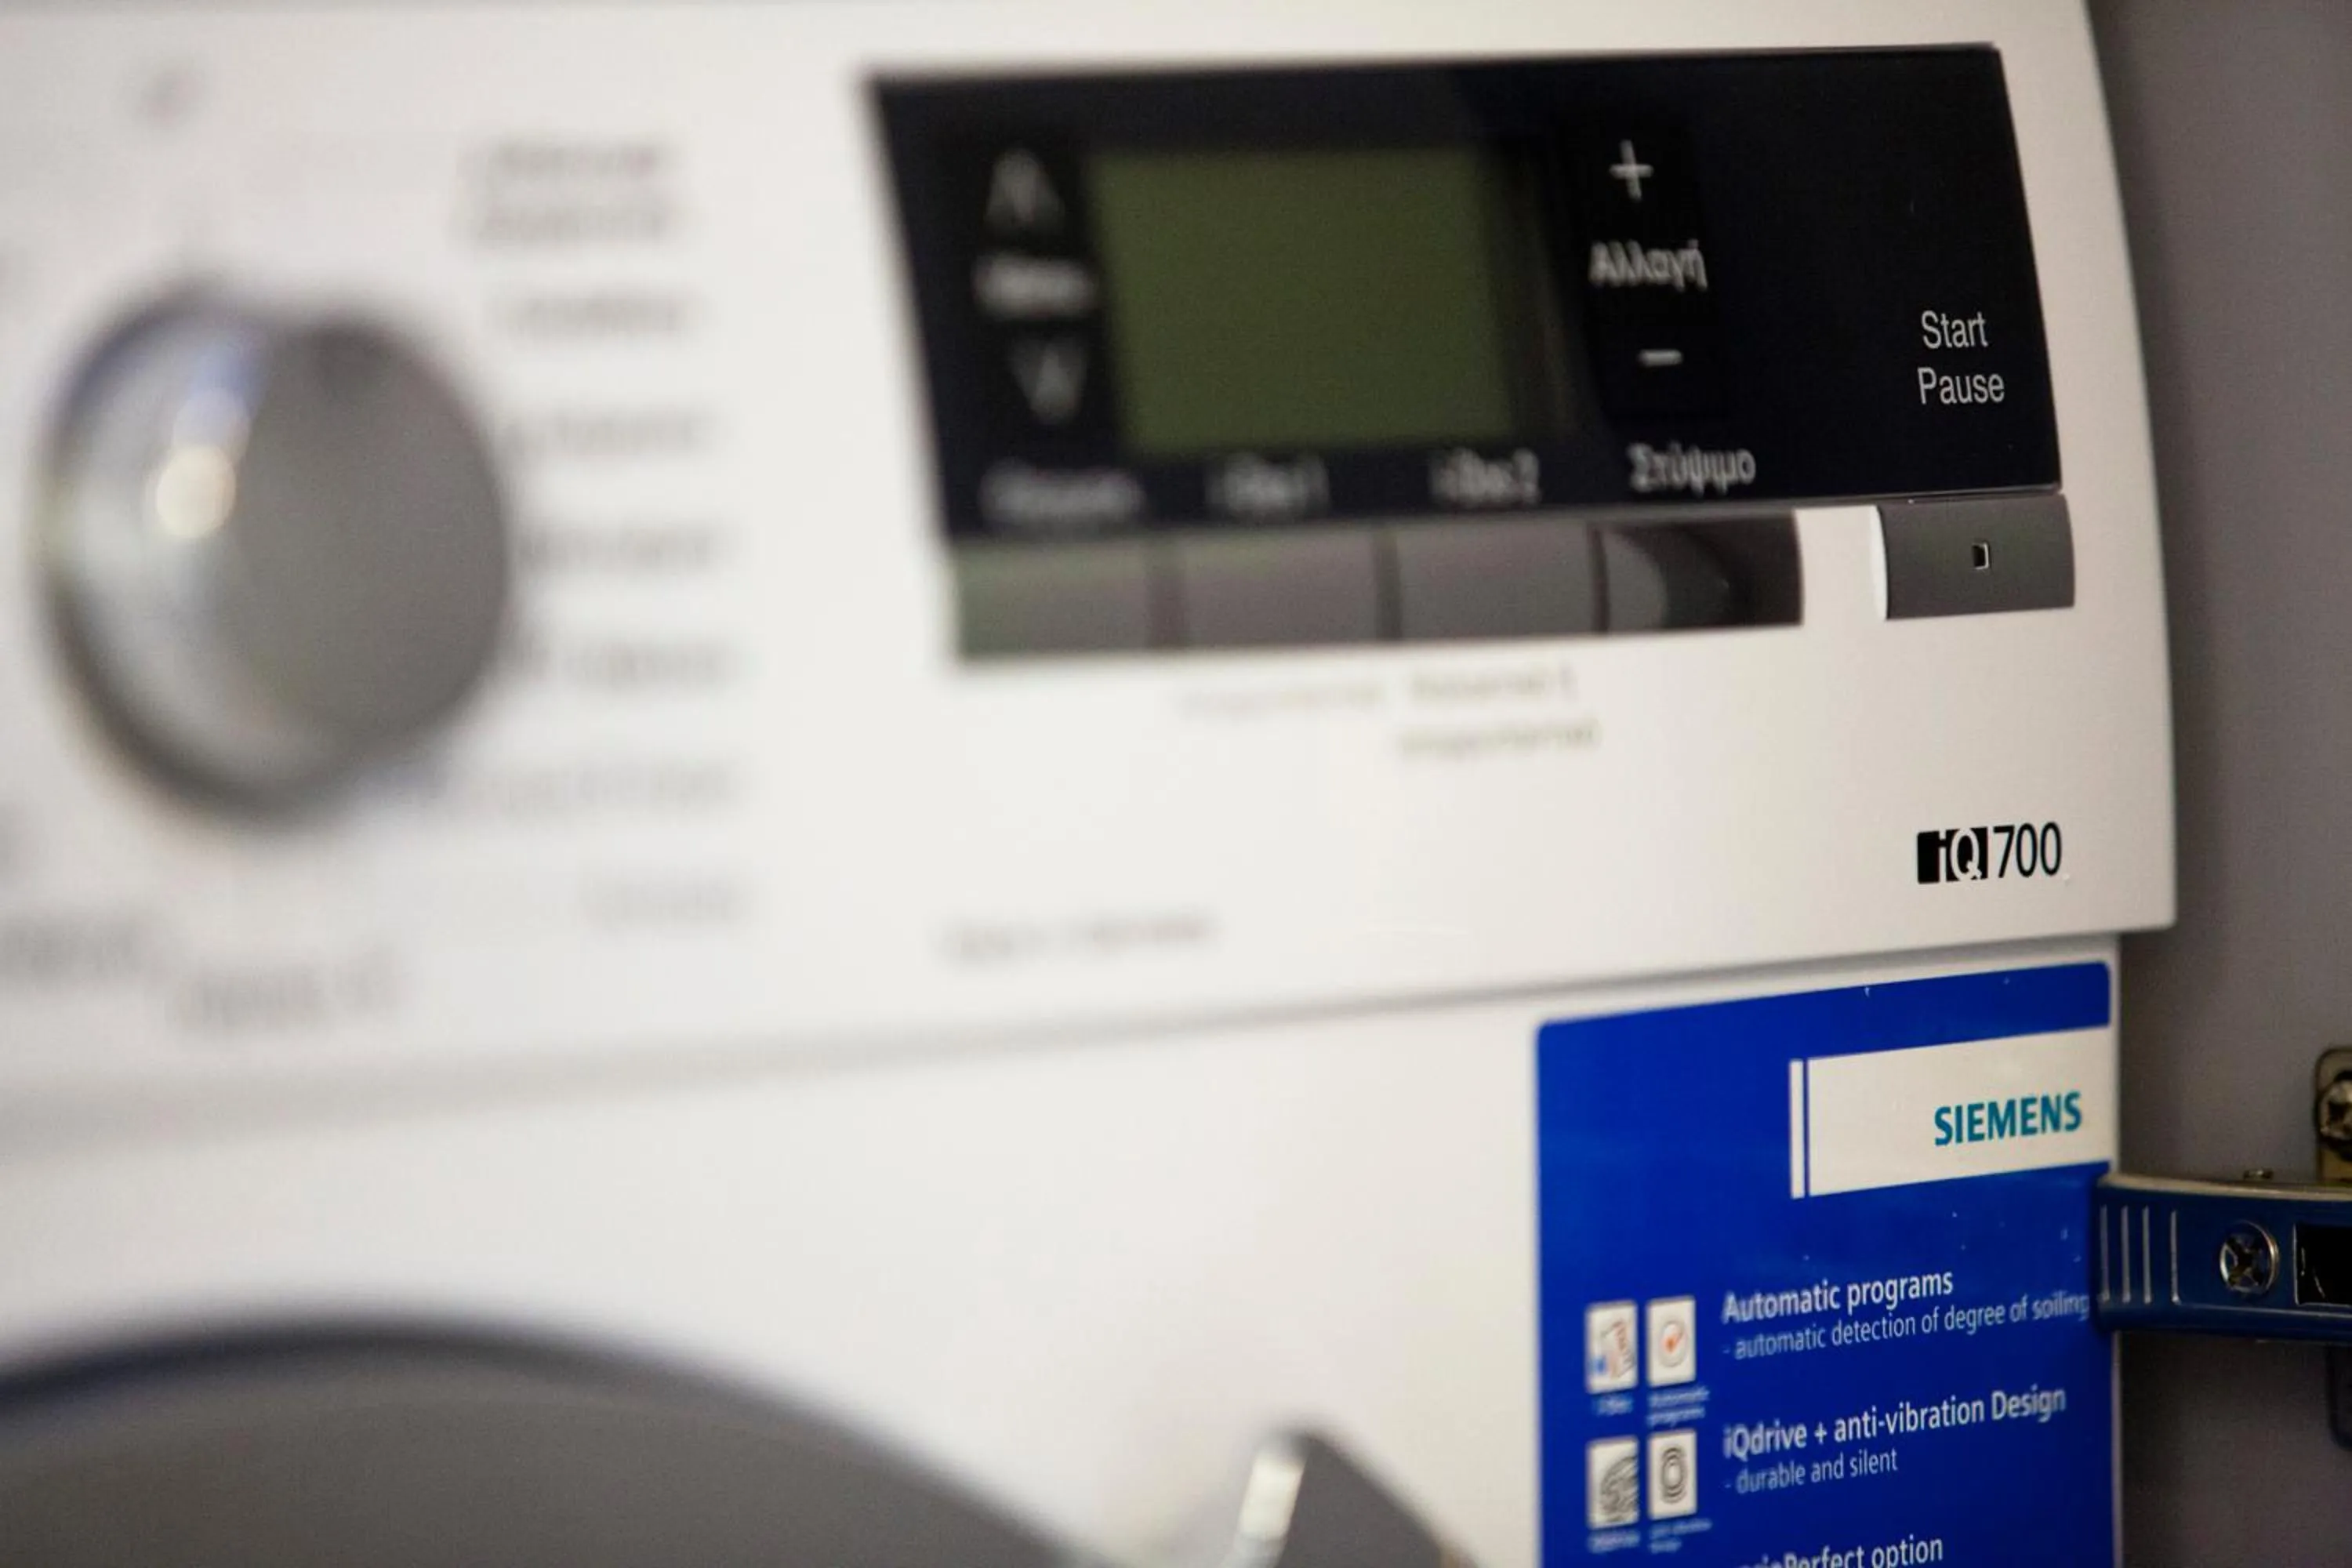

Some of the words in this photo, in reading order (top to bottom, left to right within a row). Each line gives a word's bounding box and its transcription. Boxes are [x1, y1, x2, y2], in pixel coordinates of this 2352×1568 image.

[1921, 310, 1989, 350] Start
[1917, 366, 2005, 405] Pause
[1917, 821, 2063, 884] iQ700
[1933, 1091, 2082, 1146] SIEMENS
[1722, 1276, 1842, 1325] Automatic
[1846, 1270, 1955, 1316] programs
[1733, 1321, 1827, 1360] automatic
[1831, 1312, 1916, 1347] detection
[1921, 1305, 1940, 1334] of
[1944, 1304, 2006, 1336] degree
[2009, 1294, 2028, 1323] of
[2032, 1289, 2091, 1322] soiling
[1723, 1417, 1808, 1463] iQdrive
[1813, 1421, 1828, 1446] +
[1833, 1394, 1986, 1444] anti-vibration
[1991, 1383, 2067, 1424] Design
[1736, 1461, 1806, 1495] durable
[1810, 1452, 1845, 1483] and
[1849, 1447, 1899, 1478] silent
[1736, 1544, 1864, 1568] Perfect
[1871, 1534, 1944, 1568] option
